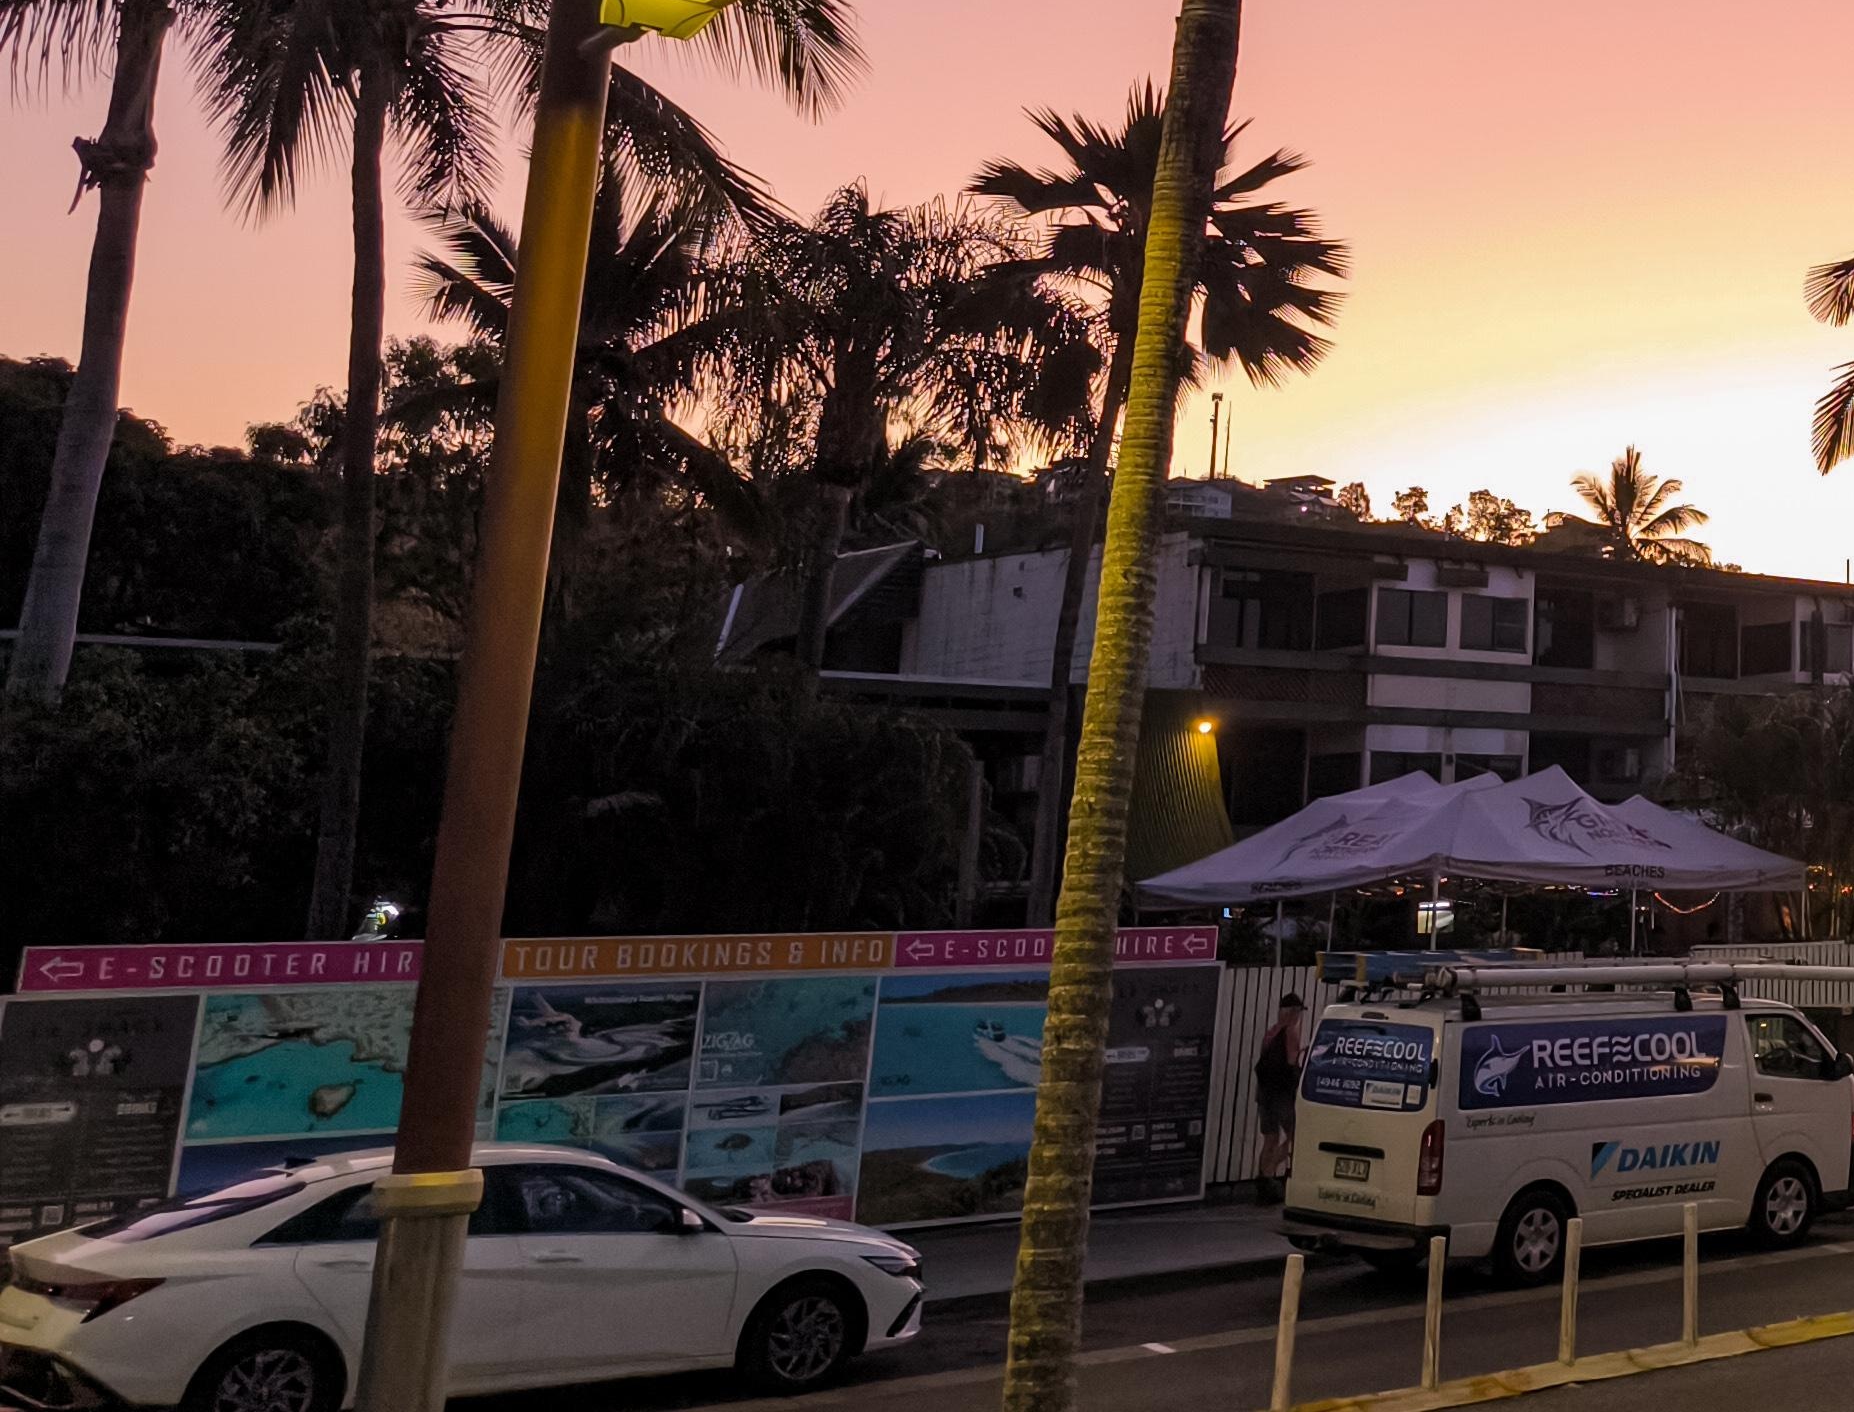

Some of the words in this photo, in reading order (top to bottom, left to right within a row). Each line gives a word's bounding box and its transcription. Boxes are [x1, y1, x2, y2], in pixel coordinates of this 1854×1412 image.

[1604, 864, 1665, 879] BEACHES
[515, 945, 599, 973] TOUR
[616, 941, 773, 969] BOOKINGS
[788, 941, 804, 965] &
[820, 939, 884, 965] INFO
[944, 938, 1046, 960] E-SCOO
[1115, 935, 1175, 955] HIRE
[99, 951, 328, 981] E-SCOOTER
[352, 950, 414, 975] HIR
[1534, 1065, 1702, 1090] AIR-CONDITIONING
[1616, 1140, 1720, 1173] DAIKIN
[1611, 1185, 1674, 1202] SPECIALIST
[1674, 1181, 1716, 1196] DEALER
